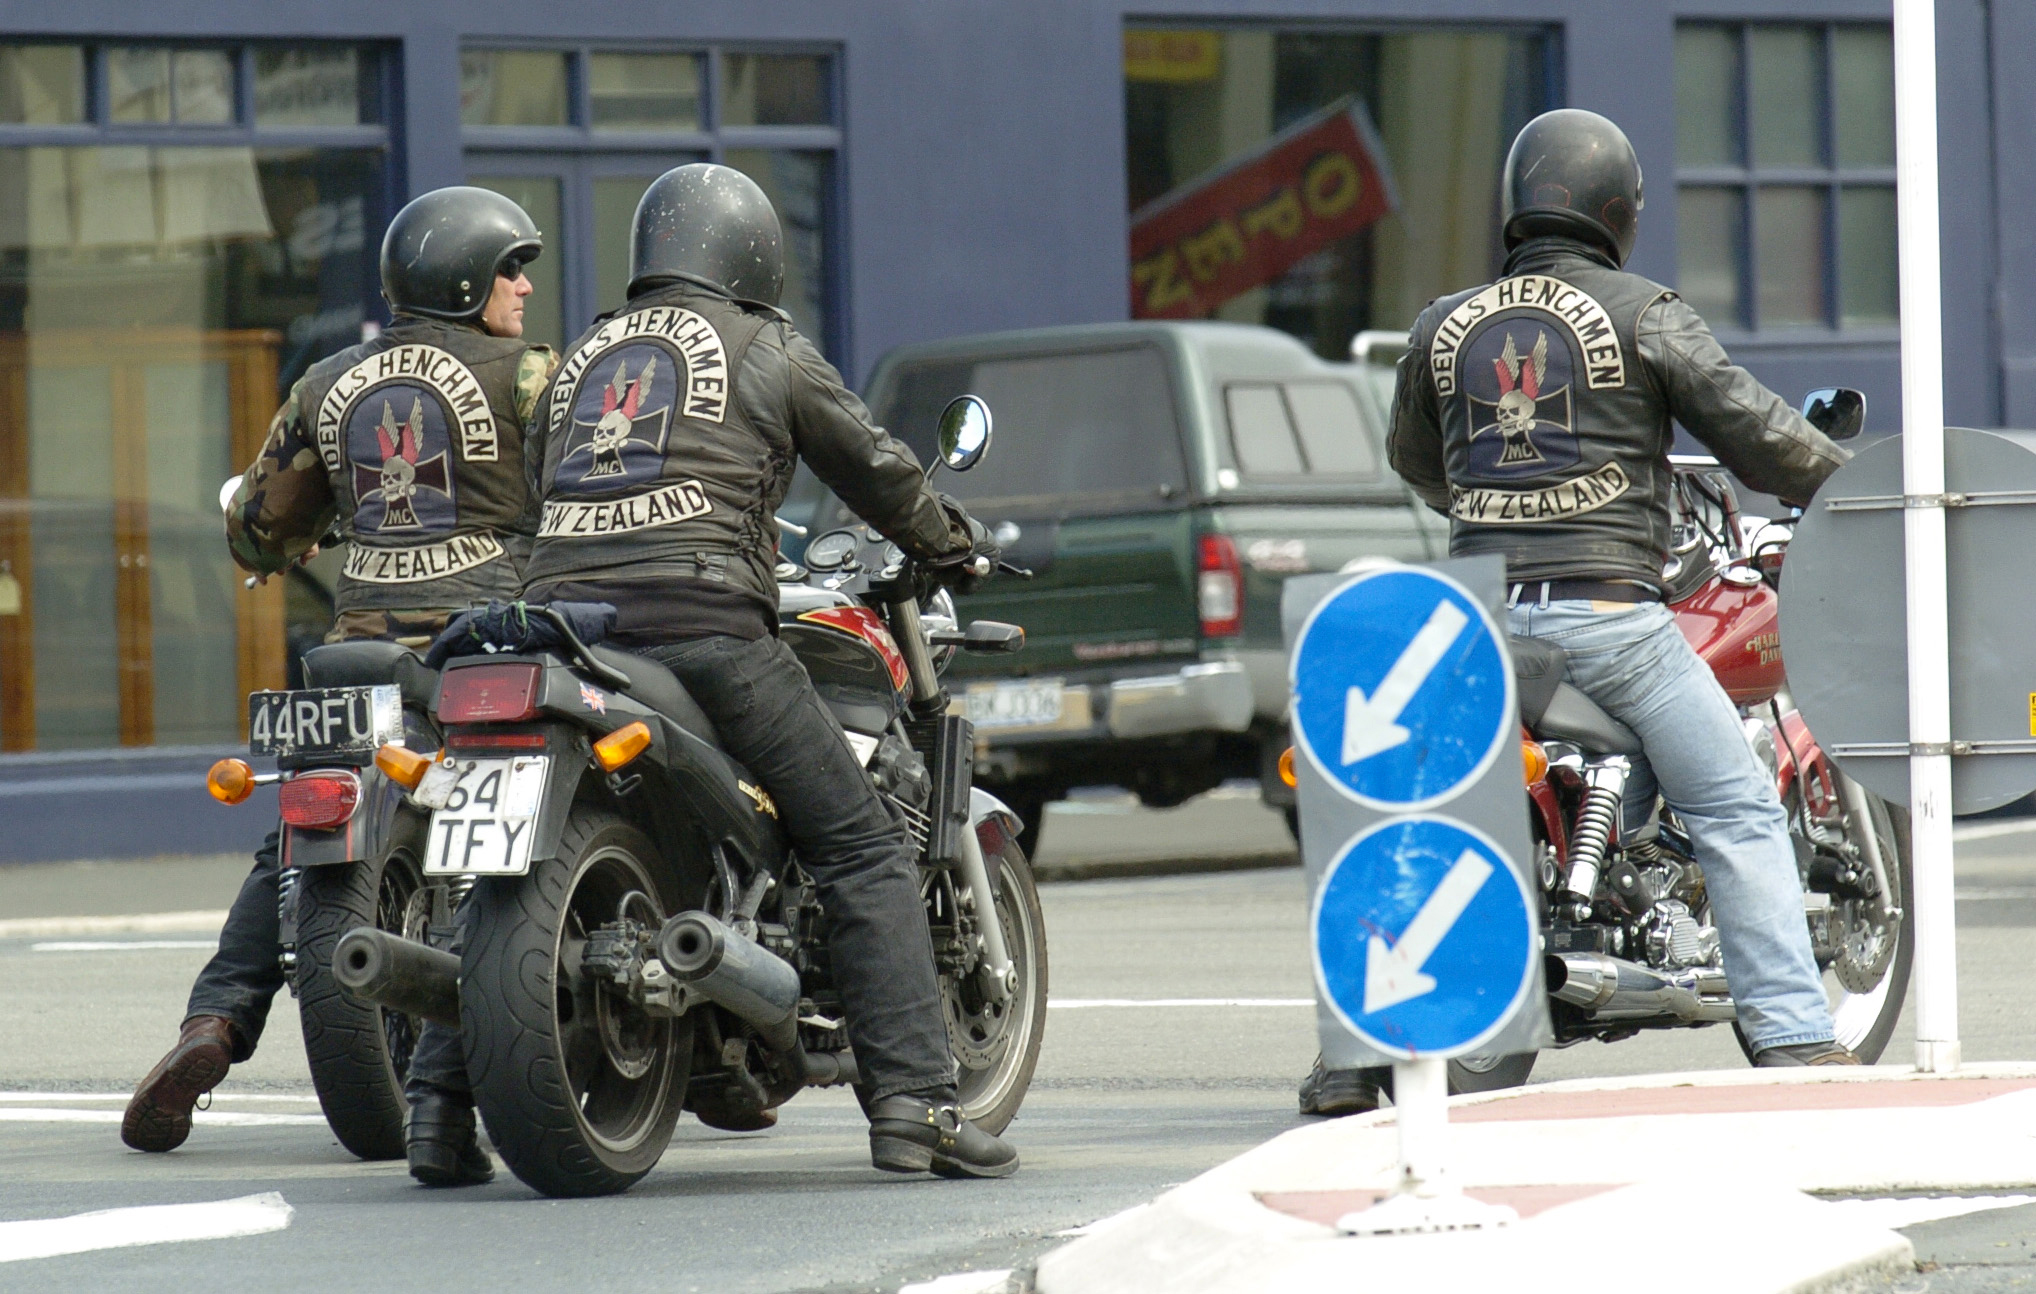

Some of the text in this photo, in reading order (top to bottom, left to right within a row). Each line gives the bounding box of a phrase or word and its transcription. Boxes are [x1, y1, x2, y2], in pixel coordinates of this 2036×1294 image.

[1132, 151, 1362, 310] OPEN
[1433, 278, 1621, 395] DEVILS HENCHMEN
[551, 310, 723, 428] DEVILS HENCHMEN
[319, 348, 495, 467] DEVILS HENCHMEN
[593, 462, 620, 475] MC
[1508, 444, 1533, 459] MC
[388, 509, 412, 525] MC
[571, 485, 705, 533] ZEALAND
[1498, 467, 1624, 520] ZEALAND
[375, 531, 497, 579] ZEALAND
[252, 697, 374, 746] 44RFU
[445, 768, 503, 813] 64
[438, 818, 528, 868] TFY
